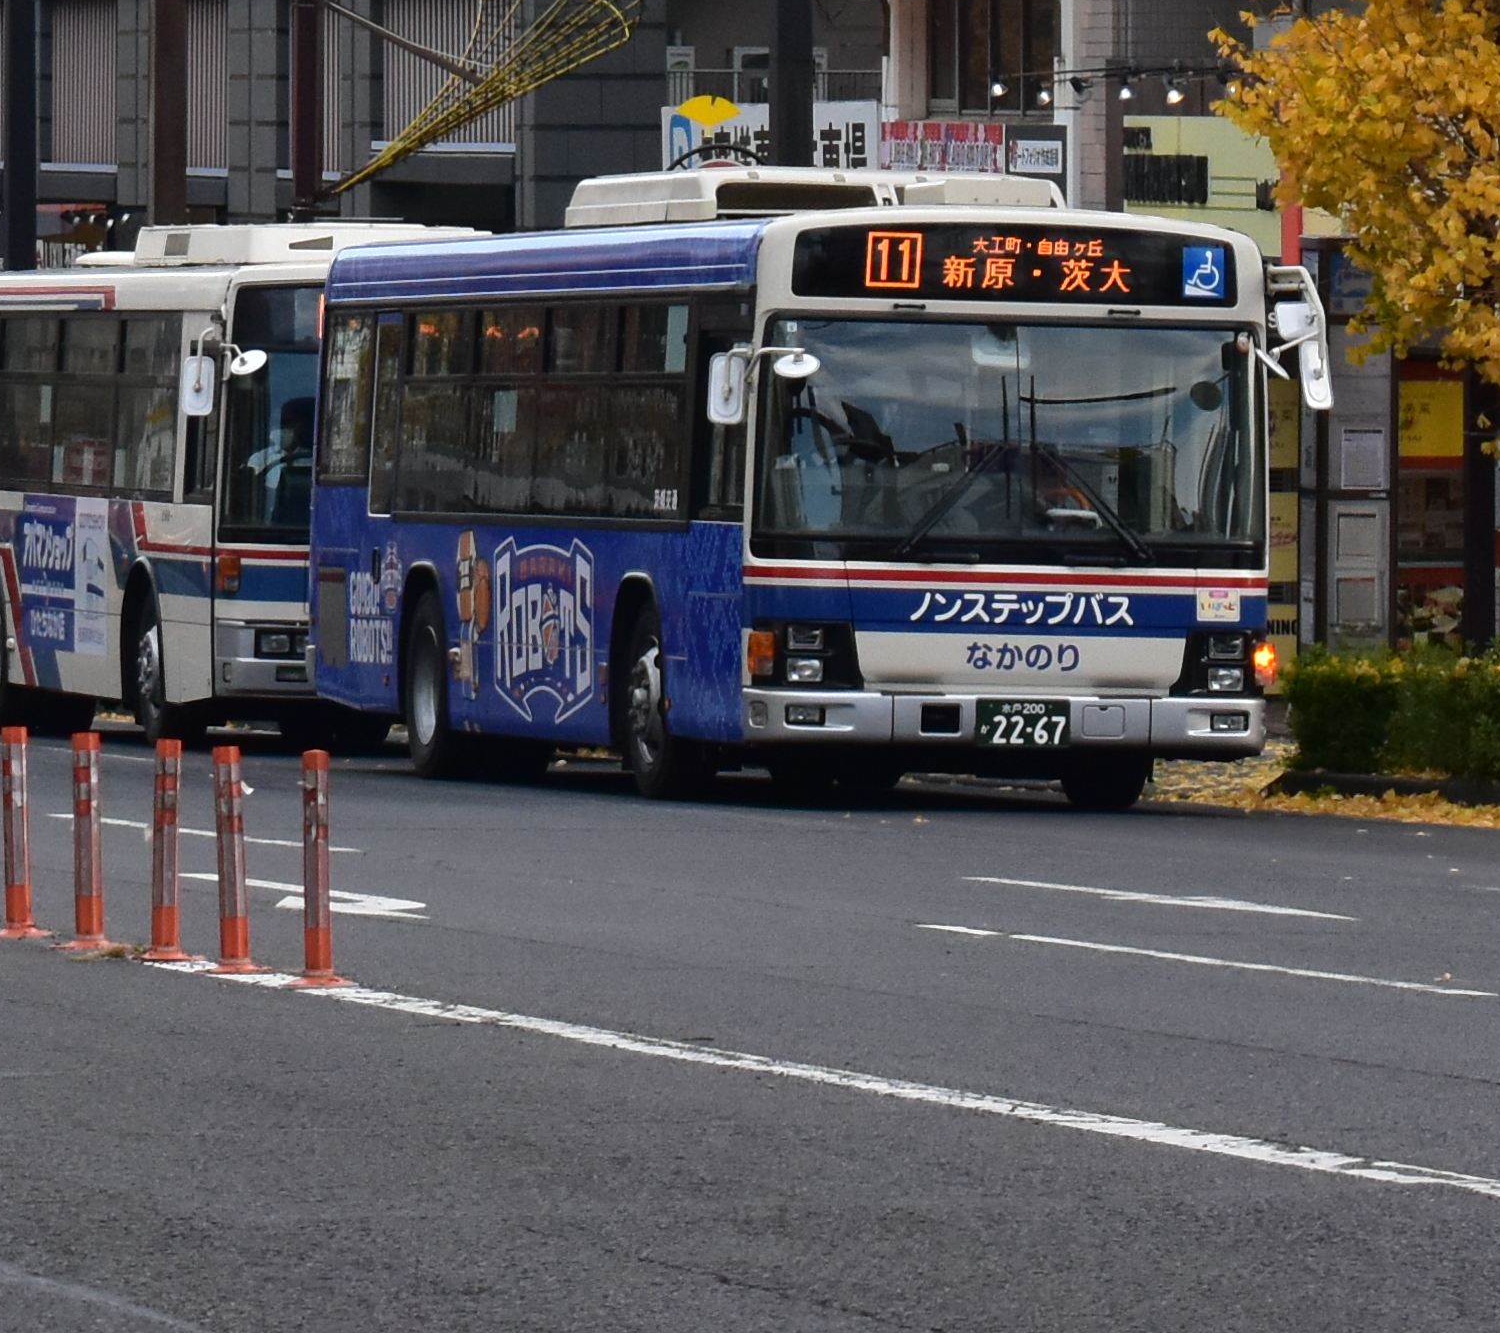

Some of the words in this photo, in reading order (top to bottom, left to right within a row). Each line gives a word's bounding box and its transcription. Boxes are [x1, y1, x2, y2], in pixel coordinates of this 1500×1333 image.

[873, 237, 913, 283] 11
[942, 256, 1132, 294] 新原・茨大
[910, 592, 1135, 627] ノンステップバス
[966, 640, 1081, 672] なかのり
[991, 715, 1068, 746] 22-67
